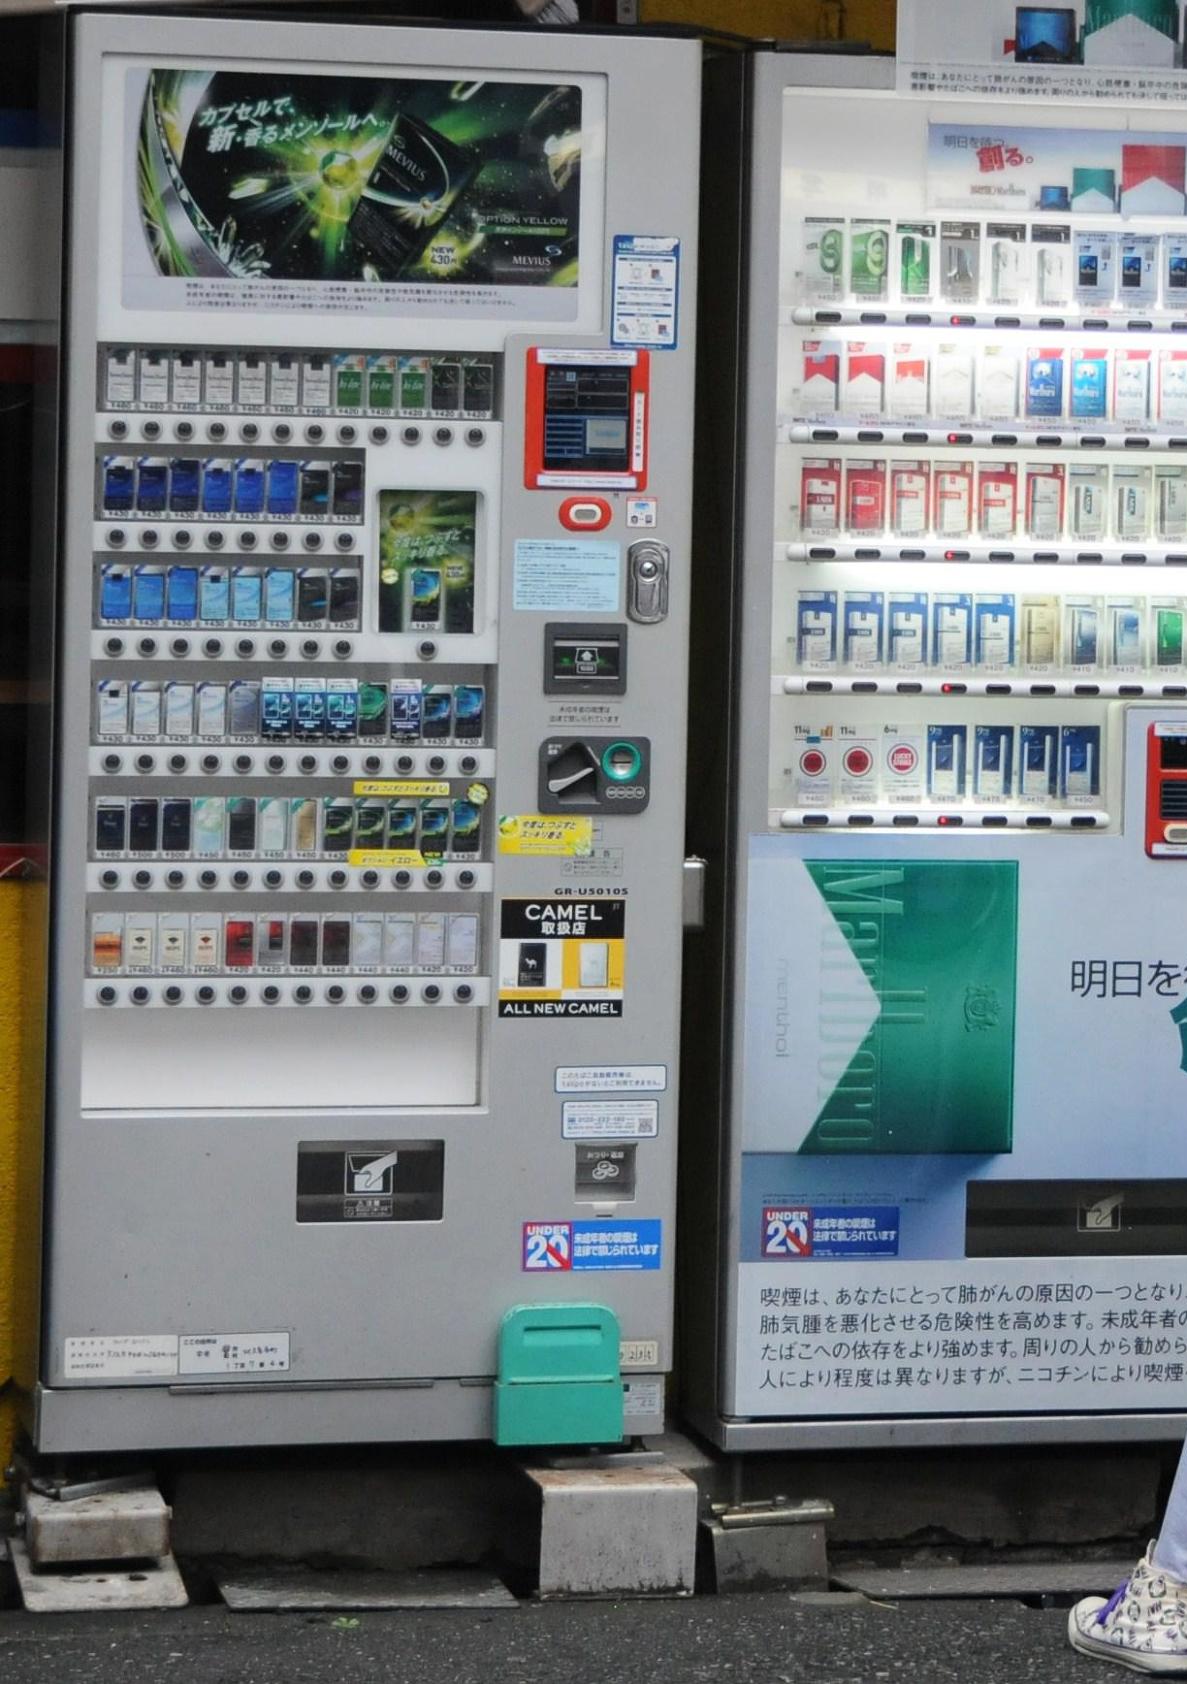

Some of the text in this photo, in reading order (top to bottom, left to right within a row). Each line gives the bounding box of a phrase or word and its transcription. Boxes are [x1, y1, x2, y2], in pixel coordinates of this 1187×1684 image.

[386, 146, 427, 182] MEVIUS
[512, 255, 551, 266] MEVIUS
[525, 904, 603, 921] CAMEL
[541, 921, 586, 935] 取扱店
[503, 1003, 618, 1014] ALL NEW CAMEL
[766, 1211, 808, 1220] UNDER
[526, 1225, 570, 1236] UNDER
[766, 1220, 808, 1253] 20
[525, 1235, 570, 1268] 20
